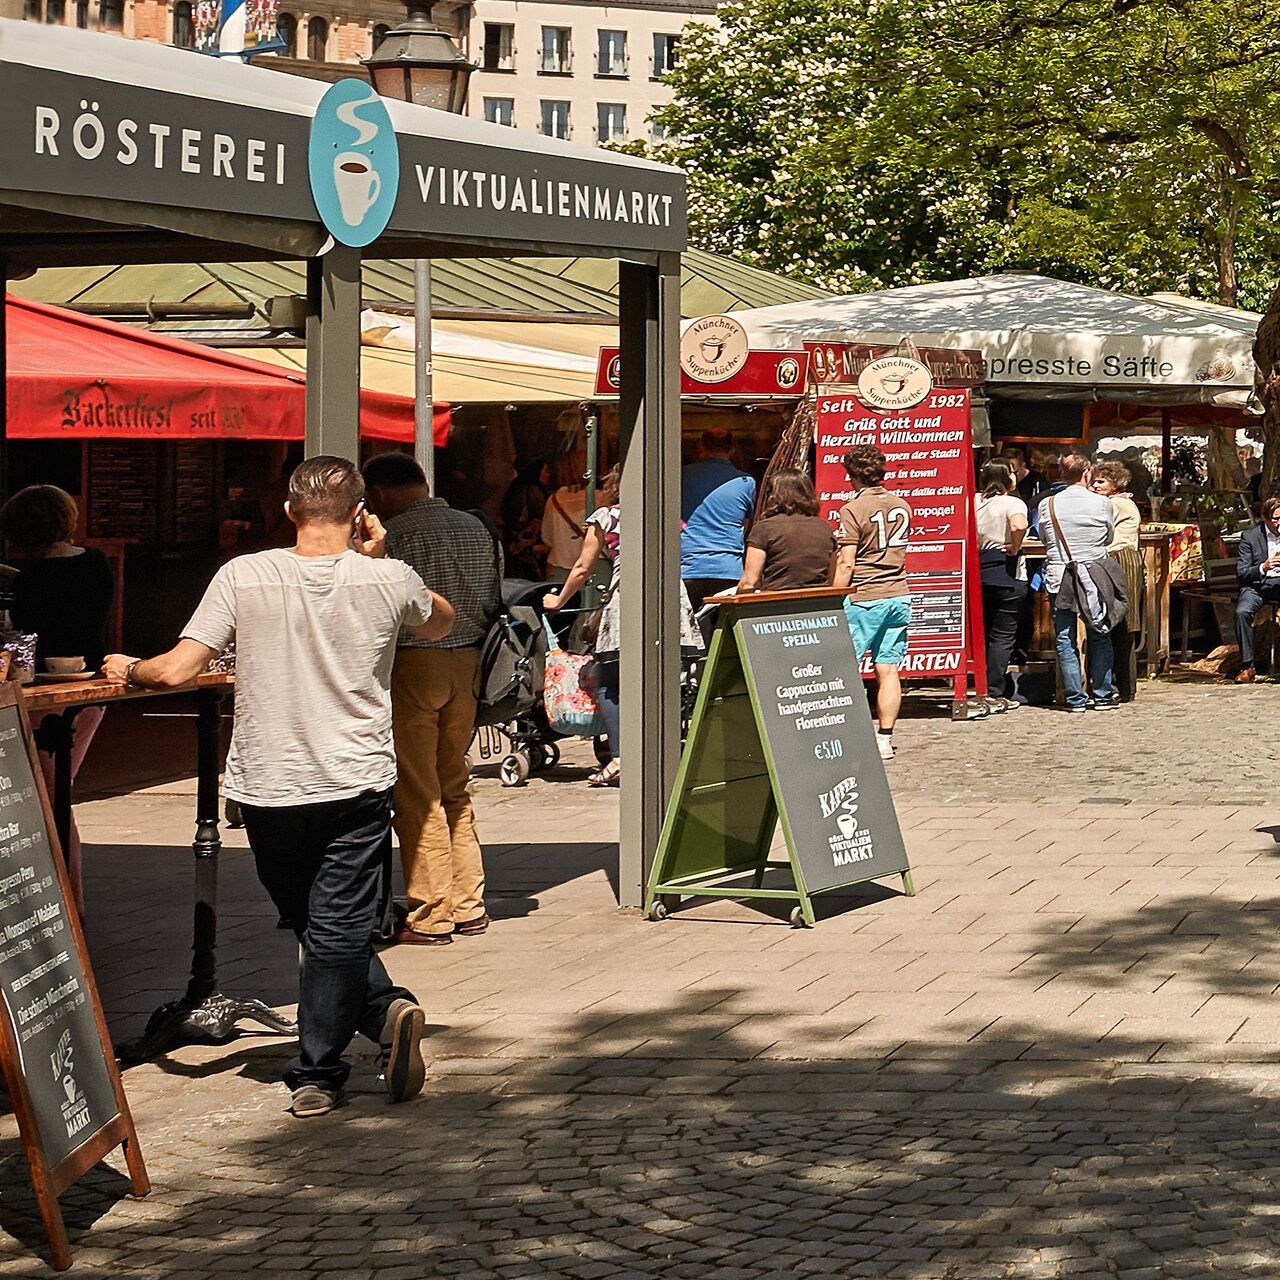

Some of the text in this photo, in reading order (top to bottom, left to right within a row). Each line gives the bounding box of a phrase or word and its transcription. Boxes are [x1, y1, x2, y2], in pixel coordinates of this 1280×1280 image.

[35, 99, 673, 227] RÖSTEREI VIKTUALIENMARKT
[694, 318, 739, 335] Münchner
[686, 354, 740, 377] Suppenküche
[872, 360, 920, 373] Münchner
[982, 355, 1174, 379] epresste Säfte
[820, 394, 965, 414] Seit 1982
[867, 387, 923, 405] Suppenküche
[844, 415, 942, 432] Grüß Gott und
[820, 430, 965, 447] Herzlich Willkommen
[823, 454, 839, 464] Die
[884, 452, 910, 463] ppen
[911, 450, 929, 460] der
[909, 467, 938, 478] town!
[831, 490, 859, 502] migli
[914, 505, 955, 519] городе!
[869, 507, 911, 549] 12
[905, 544, 945, 553] itnehmen
[752, 615, 839, 635] VIKTUALIENMARKT
[782, 633, 820, 648] SPEZIAL
[792, 664, 823, 679] Großer
[776, 677, 845, 699] Cappuccino mit
[777, 695, 853, 716] handgemachtem
[795, 713, 846, 731] Florentiner
[818, 776, 858, 818] KAFFEE
[829, 835, 872, 851] VIKTUALIEN
[832, 844, 874, 867] MARKT
[0, 873, 21, 894] spresso
[66, 1106, 91, 1138] MARKT
